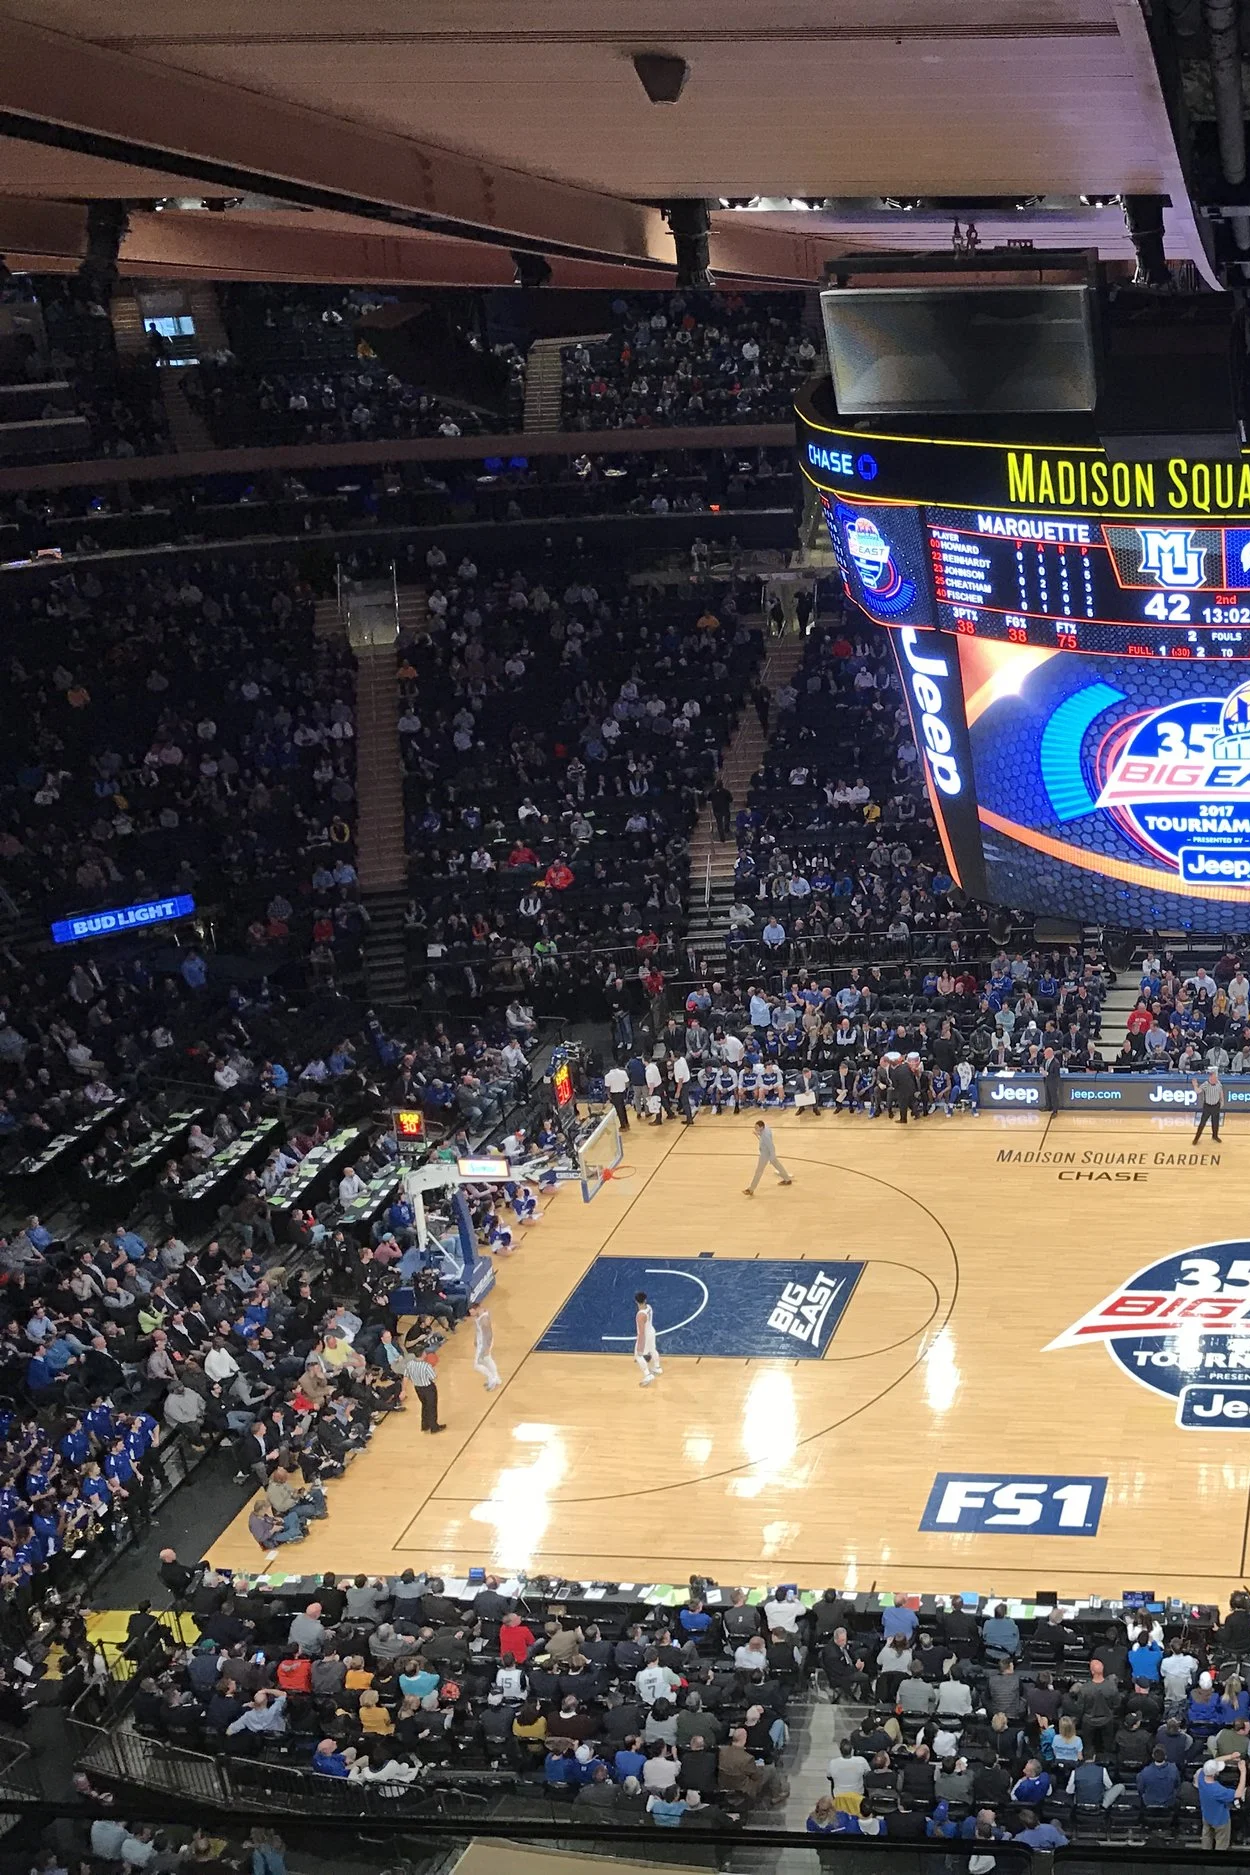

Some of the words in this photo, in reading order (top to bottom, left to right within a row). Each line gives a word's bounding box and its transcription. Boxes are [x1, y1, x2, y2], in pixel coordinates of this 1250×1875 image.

[808, 444, 853, 474] CHASE
[1007, 452, 1155, 508] MADISON
[978, 515, 1090, 543] MARQUETTE
[933, 531, 959, 542] PLAYER
[1017, 541, 1022, 549] F
[1037, 543, 1044, 552] A
[1059, 545, 1065, 554] R
[1082, 546, 1087, 555] P
[941, 542, 979, 554] HOWARD
[1038, 554, 1043, 563] 1
[1060, 556, 1065, 565] 1
[1083, 558, 1089, 567] 3
[932, 552, 942, 561] 22
[943, 553, 991, 568] REINHARDT
[1018, 565, 1023, 573] 1
[934, 564, 943, 573] 23
[944, 566, 984, 580] JOHNSON
[1040, 579, 1046, 588] 2
[1062, 582, 1068, 590] 2
[1085, 583, 1092, 592] 3
[935, 576, 945, 585] 25
[945, 578, 991, 593] CHEATHAM
[1021, 590, 1025, 598] 1
[1087, 596, 1093, 605] 2
[937, 588, 946, 597] 40
[947, 590, 983, 604] FISCHER
[1043, 604, 1048, 613] 1
[1145, 593, 1190, 620] 42
[1216, 595, 1236, 604] 2nd
[953, 607, 978, 621] 3PT%
[1006, 616, 1027, 629] FG%
[1056, 622, 1077, 635] FT%
[1203, 608, 1250, 623] 13:02
[957, 620, 975, 634] 38
[1008, 629, 1027, 642] 38
[1058, 635, 1077, 648] 75
[1188, 631, 1197, 642] 2
[1212, 632, 1241, 641] FOULS
[1159, 646, 1166, 656] 1
[1197, 647, 1205, 657] 2
[1221, 648, 1233, 657] TO
[902, 627, 962, 795] Jeep
[1117, 762, 1204, 785] BIG
[1200, 805, 1234, 816] 2017
[1188, 855, 1250, 878] Jeep
[73, 916, 116, 935] BUD
[117, 902, 174, 926] LIGHT
[991, 1084, 1039, 1103] Jeep
[1071, 1088, 1121, 1100] jeep.com
[1149, 1086, 1197, 1106] Jeep
[996, 1150, 1076, 1164] MADISON
[1081, 1150, 1146, 1165] SQUARE
[1153, 1152, 1221, 1166] GARDEN
[1058, 1171, 1149, 1182] CHASE
[767, 1281, 808, 1333] BIG
[788, 1270, 837, 1341] EAST
[1099, 1295, 1247, 1318] BIG
[935, 1481, 1092, 1528] FS1
